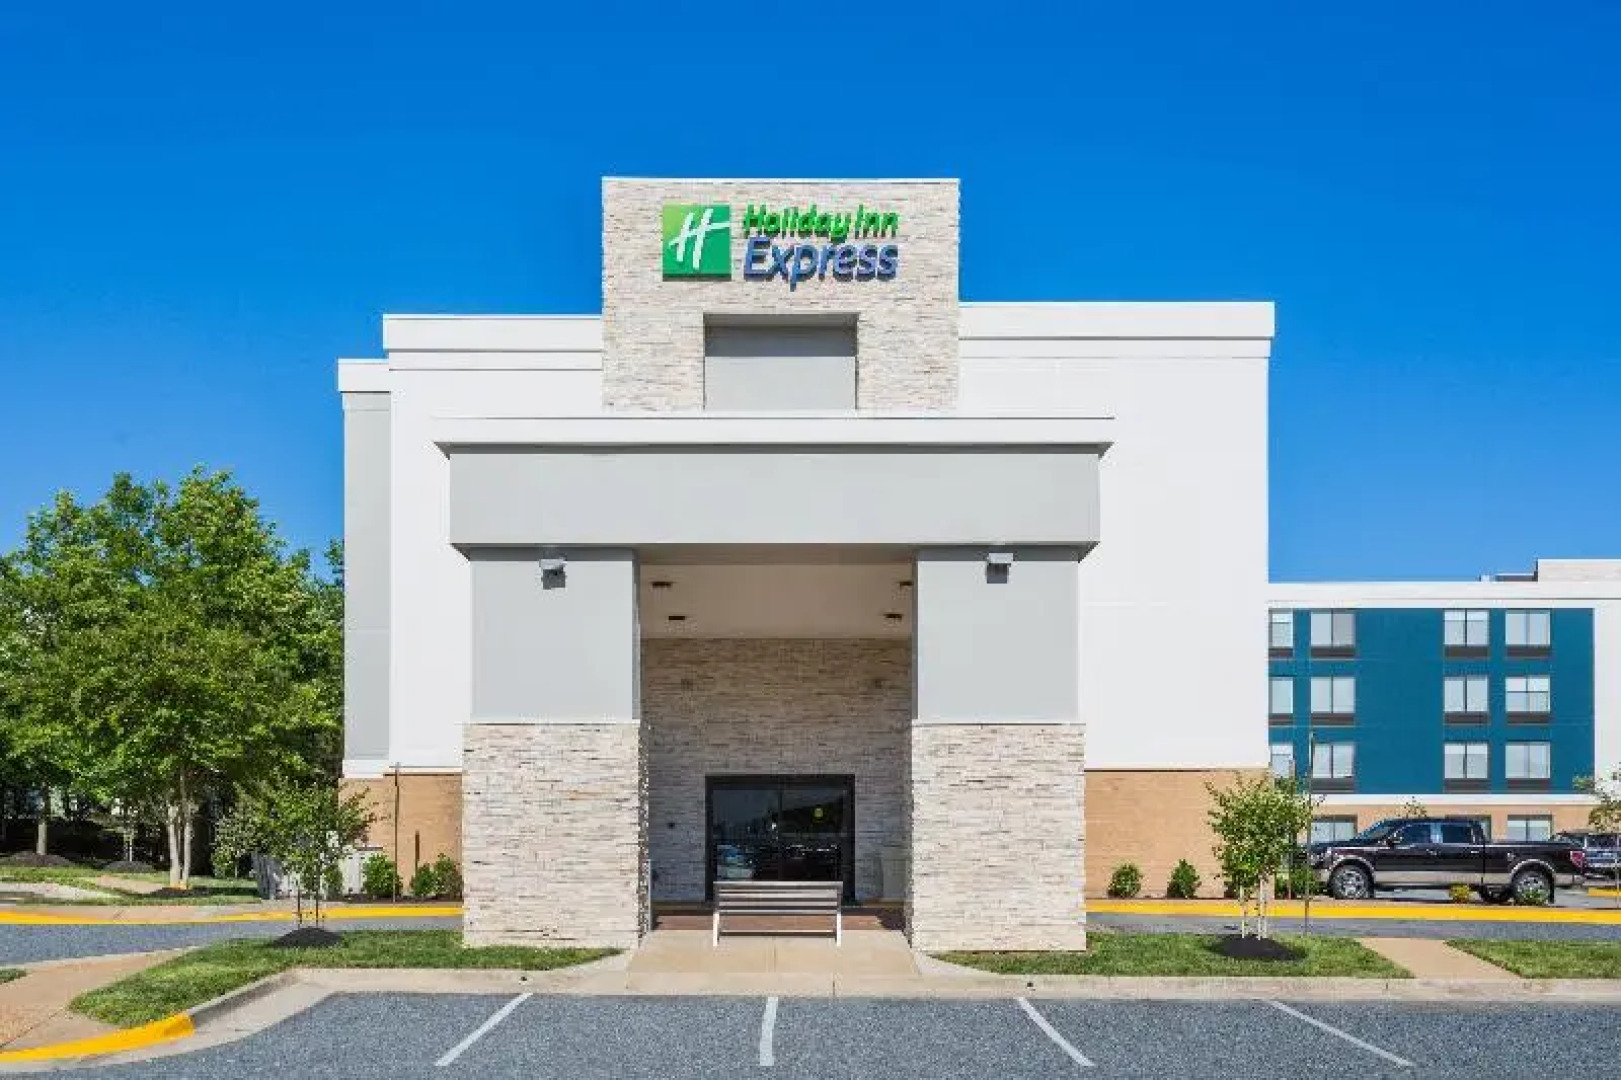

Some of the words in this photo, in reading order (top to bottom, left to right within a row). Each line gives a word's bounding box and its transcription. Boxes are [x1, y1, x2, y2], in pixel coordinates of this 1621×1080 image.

[743, 204, 850, 241] Holiday
[854, 204, 899, 236] Inn
[743, 237, 899, 291] Express
